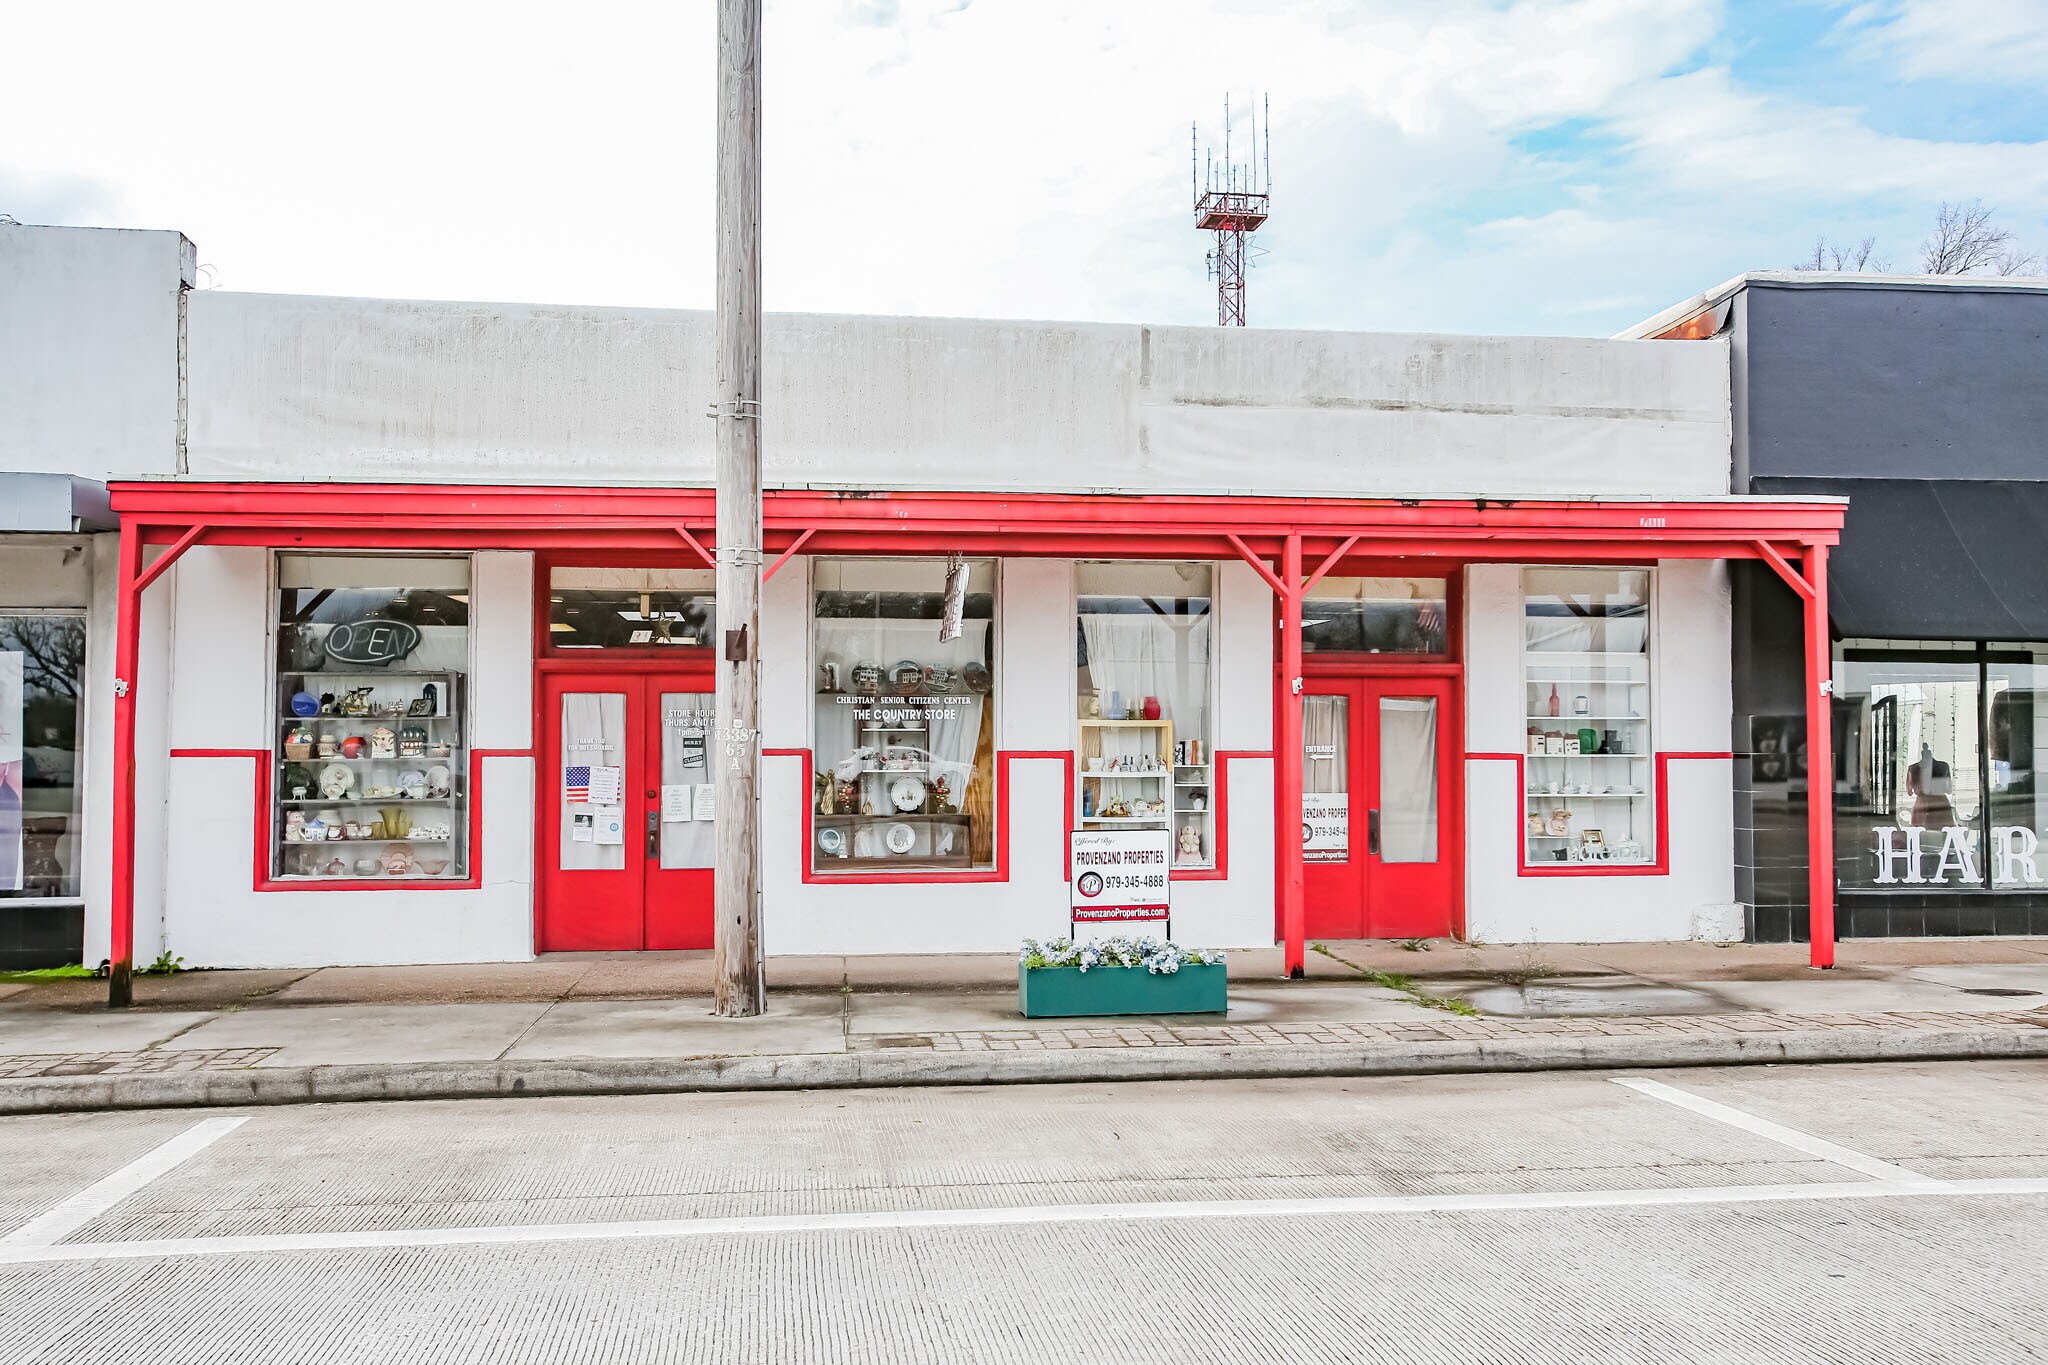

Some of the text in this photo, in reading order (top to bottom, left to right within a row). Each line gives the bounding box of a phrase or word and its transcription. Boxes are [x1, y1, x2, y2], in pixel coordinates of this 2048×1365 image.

[330, 624, 409, 656] OPEN
[836, 696, 972, 705] CHRISTIAN SENIOR CITIZENS CENTER
[668, 709, 691, 718] STORE
[853, 709, 956, 720] THE COUNTRY STORE
[692, 719, 708, 727] AND
[1305, 745, 1337, 753] ENTRANCE
[1328, 808, 1348, 818] PROPER
[1315, 826, 1348, 837] 979-345-4
[1075, 837, 1100, 846] Offered
[1076, 850, 1164, 865] PROVENZANO PROPERTIES
[1105, 875, 1164, 889] 979-345-4888
[1075, 907, 1166, 919] ProvenzanoProperties.com
